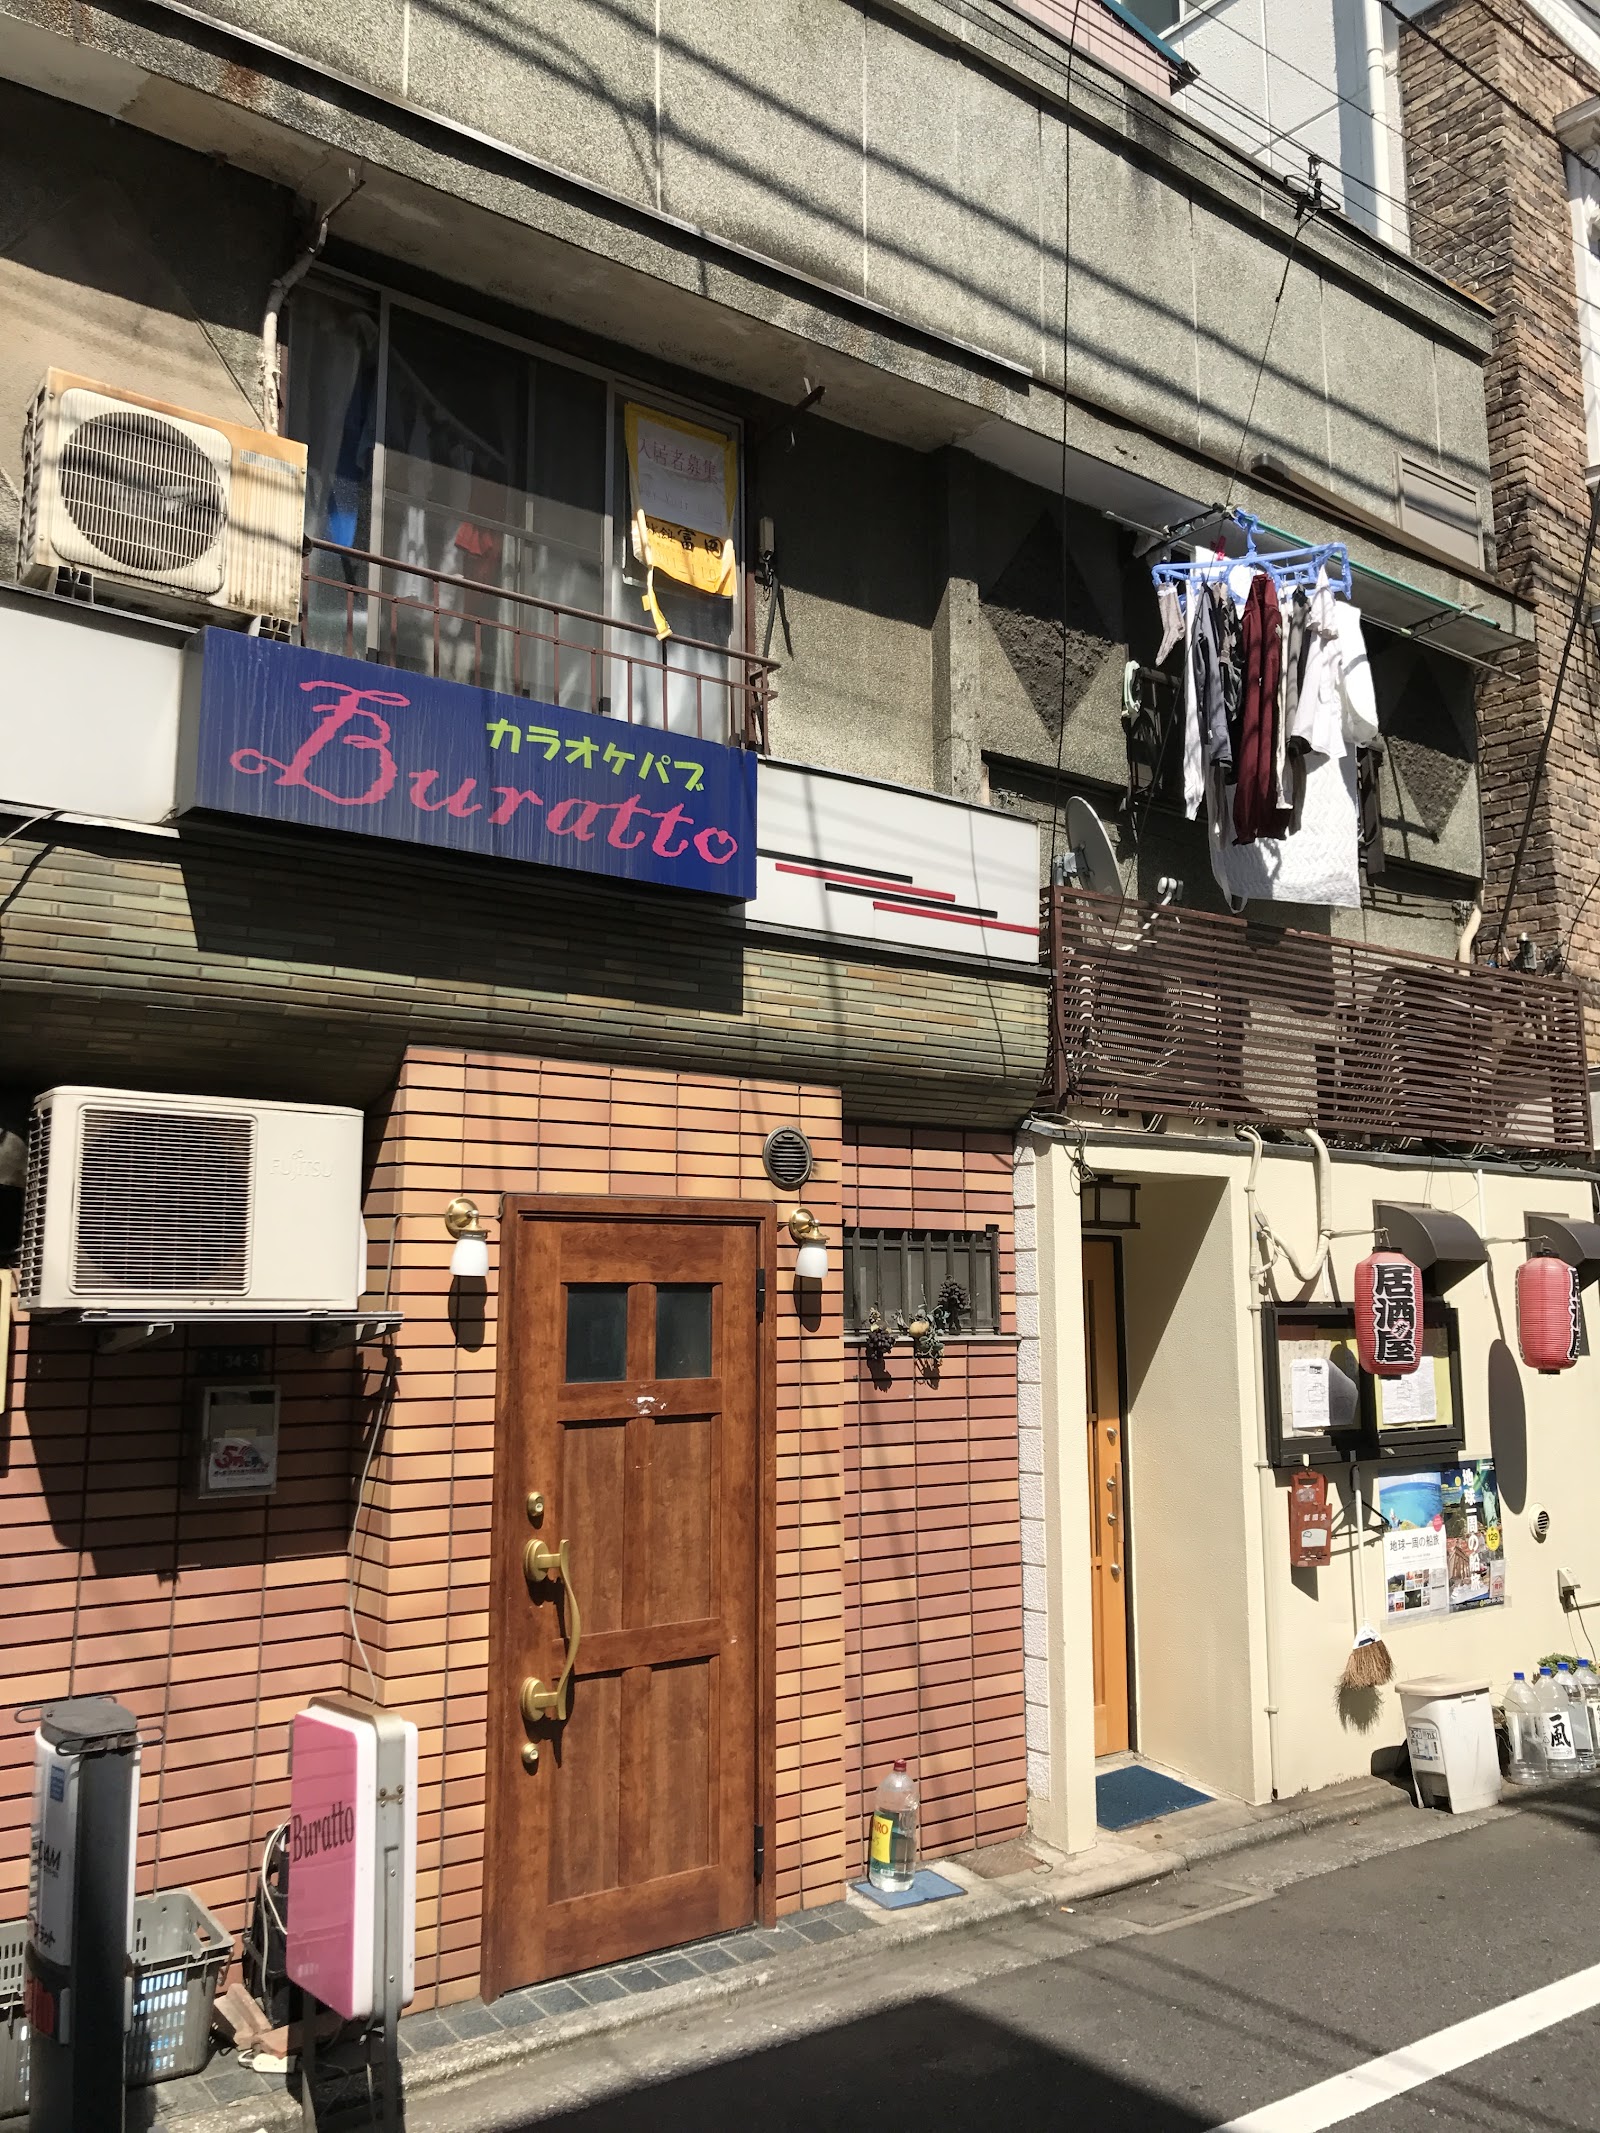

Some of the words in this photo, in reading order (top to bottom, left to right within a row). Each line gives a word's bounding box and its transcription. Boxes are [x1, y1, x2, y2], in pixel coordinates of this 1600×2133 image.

[638, 439, 719, 485] 入居者募集
[229, 680, 739, 865] Buratto
[486, 718, 705, 792] カラオケパブ
[267, 1158, 337, 1182] FUJITSU
[1374, 1264, 1416, 1364] 居酒屋
[1389, 1533, 1440, 1552] 地球一周の船旅
[1462, 1468, 1482, 1591] 地球一周の船旅
[292, 1801, 355, 1863] Buratto
